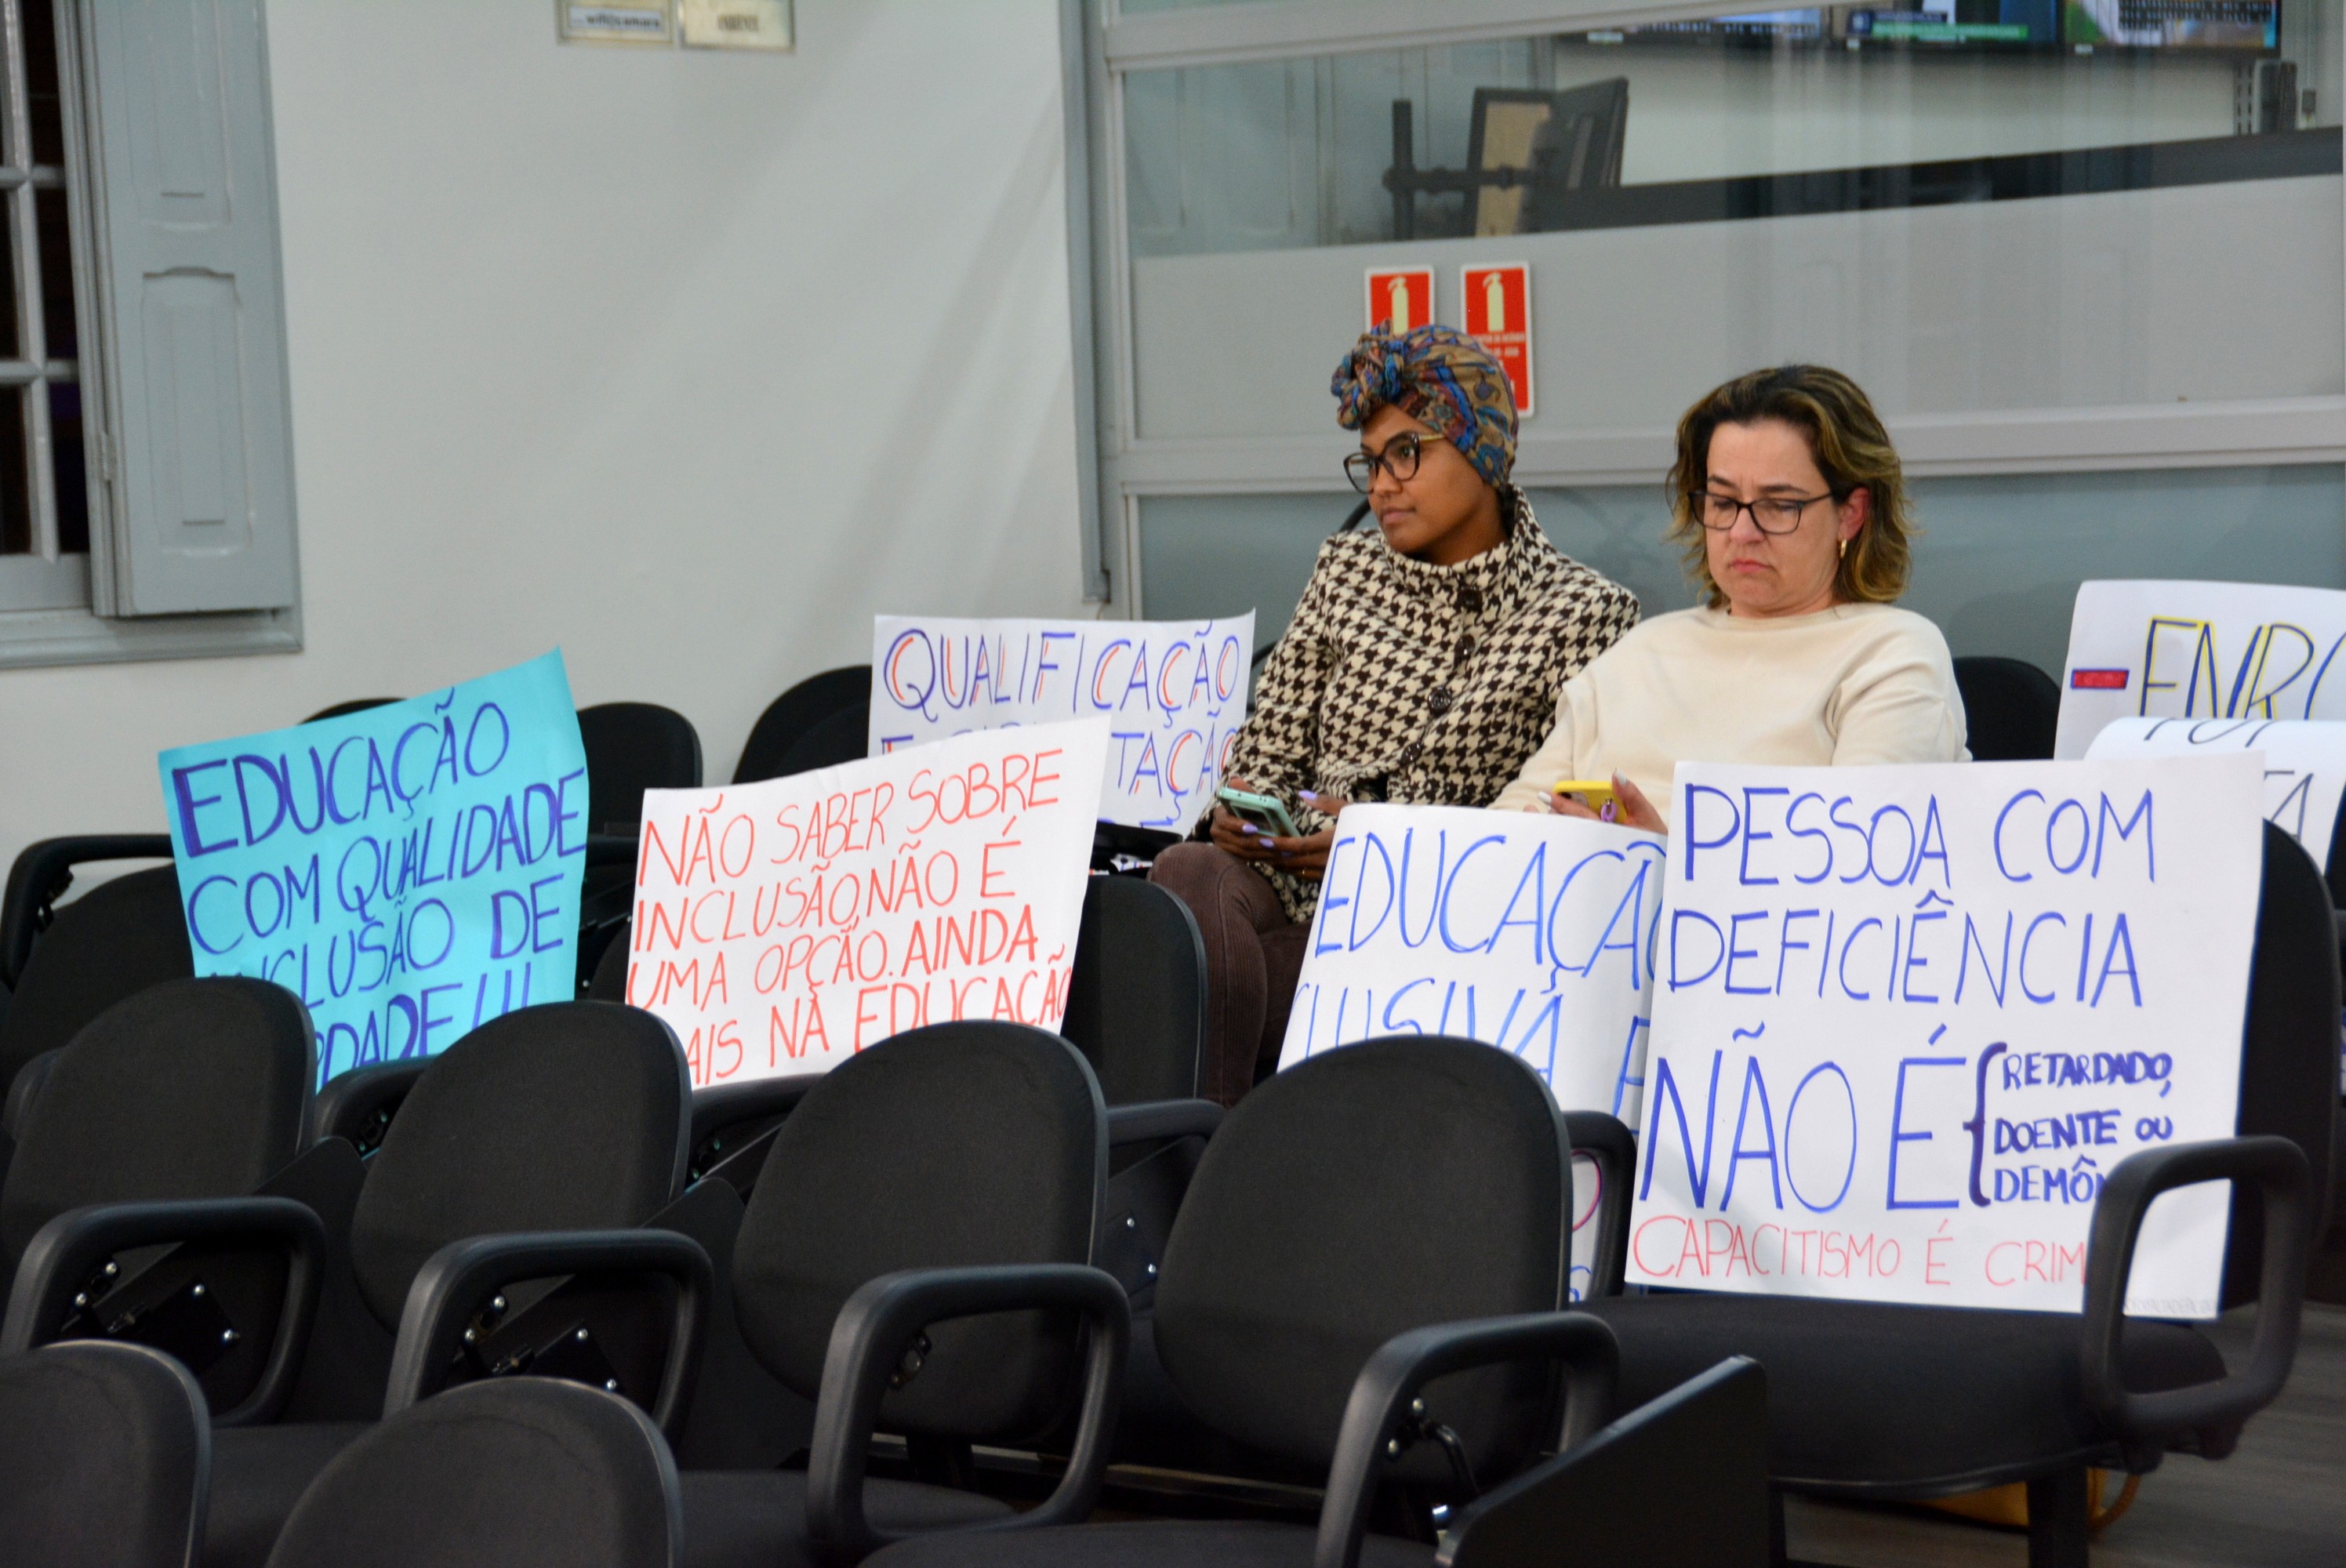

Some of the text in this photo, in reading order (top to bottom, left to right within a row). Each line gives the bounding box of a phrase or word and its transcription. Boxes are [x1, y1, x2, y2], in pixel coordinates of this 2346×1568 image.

[884, 619, 1240, 728] QUALIFICAÇÃO
[172, 686, 510, 858] EDUCAÇÃO
[638, 748, 1063, 887] NÃO SABER SOBRE
[187, 767, 586, 955] COM QUALIDADE
[979, 816, 1022, 898] É
[1685, 783, 1951, 887] PESSOA
[1993, 789, 2155, 883] COM
[490, 873, 565, 960] DE
[626, 950, 728, 1011] UMA
[901, 904, 1038, 977] AINDA
[1668, 890, 2143, 1008] DEFICIÊNCIA
[769, 997, 830, 1068] NA
[2003, 1051, 2173, 1098] RETARDADO,
[1640, 1022, 1858, 1213] NÃO
[1885, 1023, 1967, 1210] É
[1994, 1109, 2174, 1155] DOENTE OU
[1633, 1214, 2086, 1287] CAPACITISMO É CRIM
